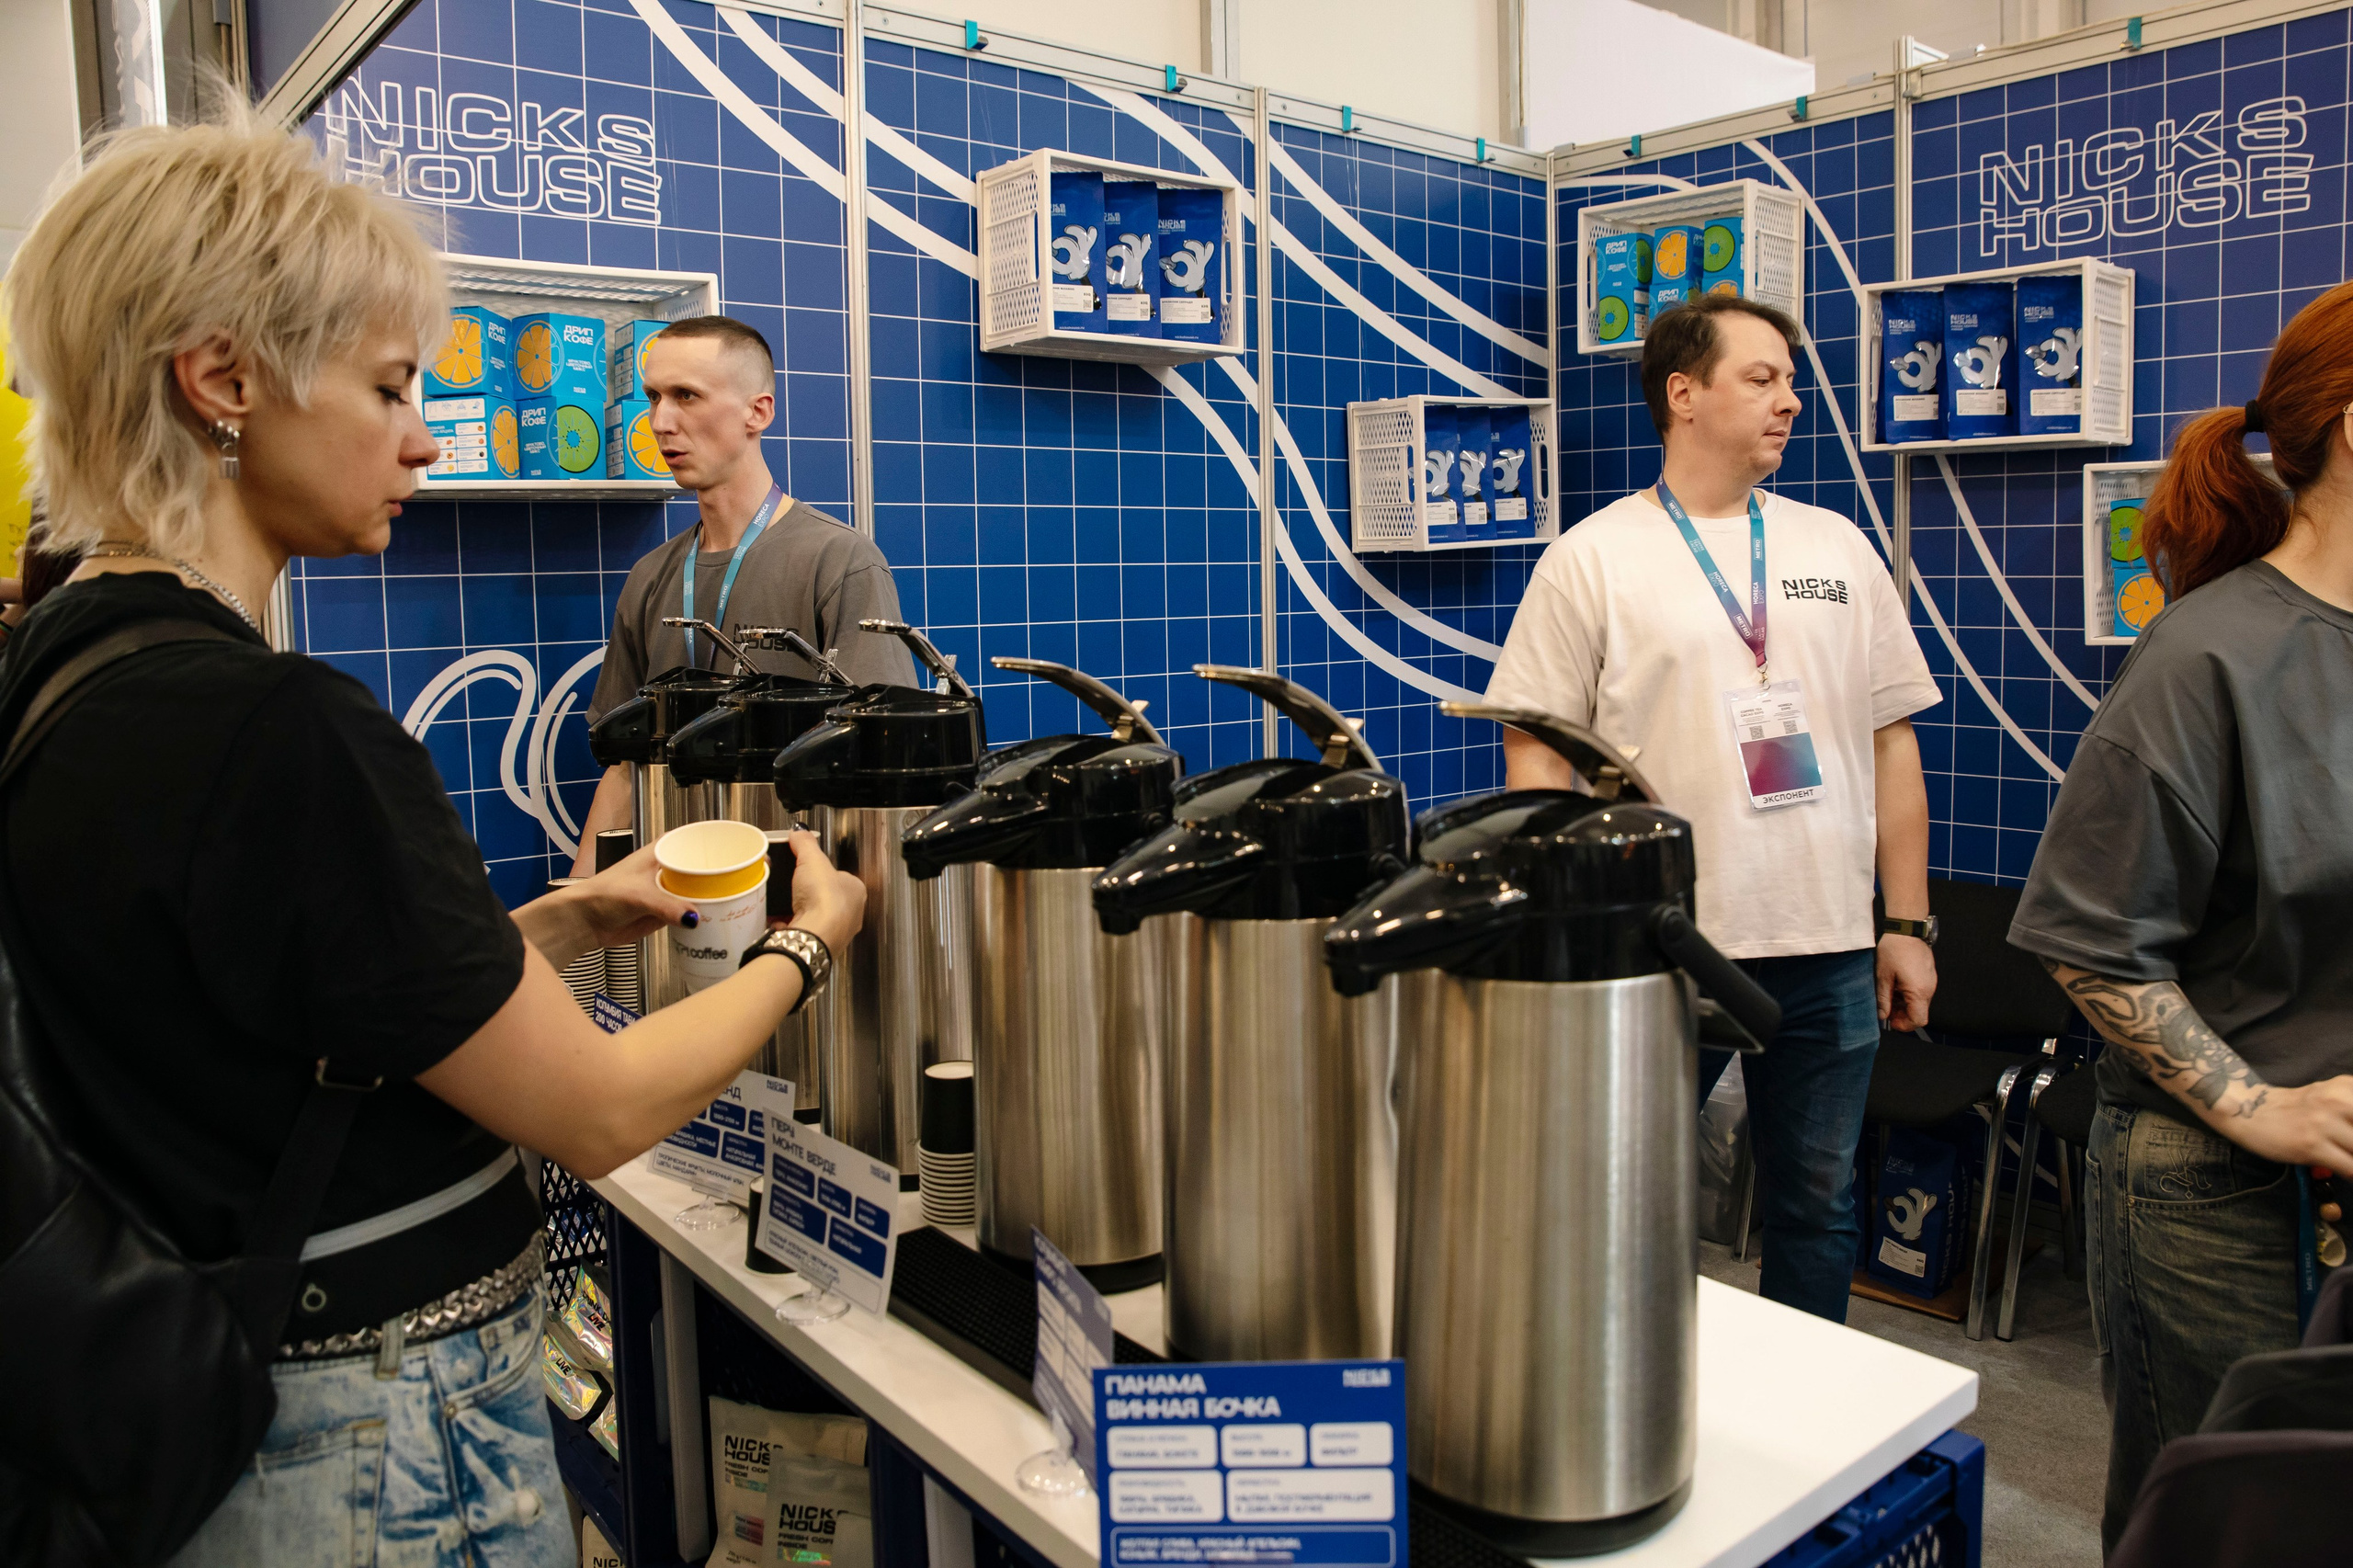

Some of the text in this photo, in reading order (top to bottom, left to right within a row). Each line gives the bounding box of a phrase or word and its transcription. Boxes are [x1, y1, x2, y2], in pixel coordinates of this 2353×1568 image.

[325, 75, 655, 166] NICKS
[1980, 96, 2307, 206] NICKS
[326, 132, 663, 225] HOUSE
[1980, 153, 2314, 256] HOUSE
[1606, 246, 1627, 255] КОФЕ
[488, 328, 506, 345] КОФЕ
[489, 322, 506, 335] ДРИП
[565, 324, 593, 336] ДРИП
[563, 331, 593, 346] КОФЕ
[521, 416, 546, 426] КОФЕ
[522, 407, 546, 417] ДРИП
[754, 503, 770, 525] HORECA
[1668, 502, 1682, 519] METRO
[1713, 571, 1728, 593] HORECA
[1781, 578, 1847, 591] NICKS
[720, 585, 728, 608] METRO
[1785, 589, 1848, 605] HOUSE
[1735, 615, 1751, 637] METRO
[1762, 789, 1814, 804] ЭКСПОНЕНТ
[690, 948, 728, 960] coffee
[597, 997, 622, 1020] КОЛУМБИЯ
[771, 1116, 795, 1138] ПЕРУ
[773, 1133, 835, 1176] МОНТЕ ВЕРДЕ
[556, 1358, 571, 1376] LIVE
[1104, 1373, 1208, 1396] ПАНАМА
[1106, 1395, 1281, 1421] ВИННАЯ БОЧКА
[725, 1435, 783, 1452] NICK
[725, 1448, 770, 1466] HOUS
[780, 1504, 849, 1520] NICK
[779, 1517, 836, 1535] HOUS
[594, 1557, 623, 1568] NIC
